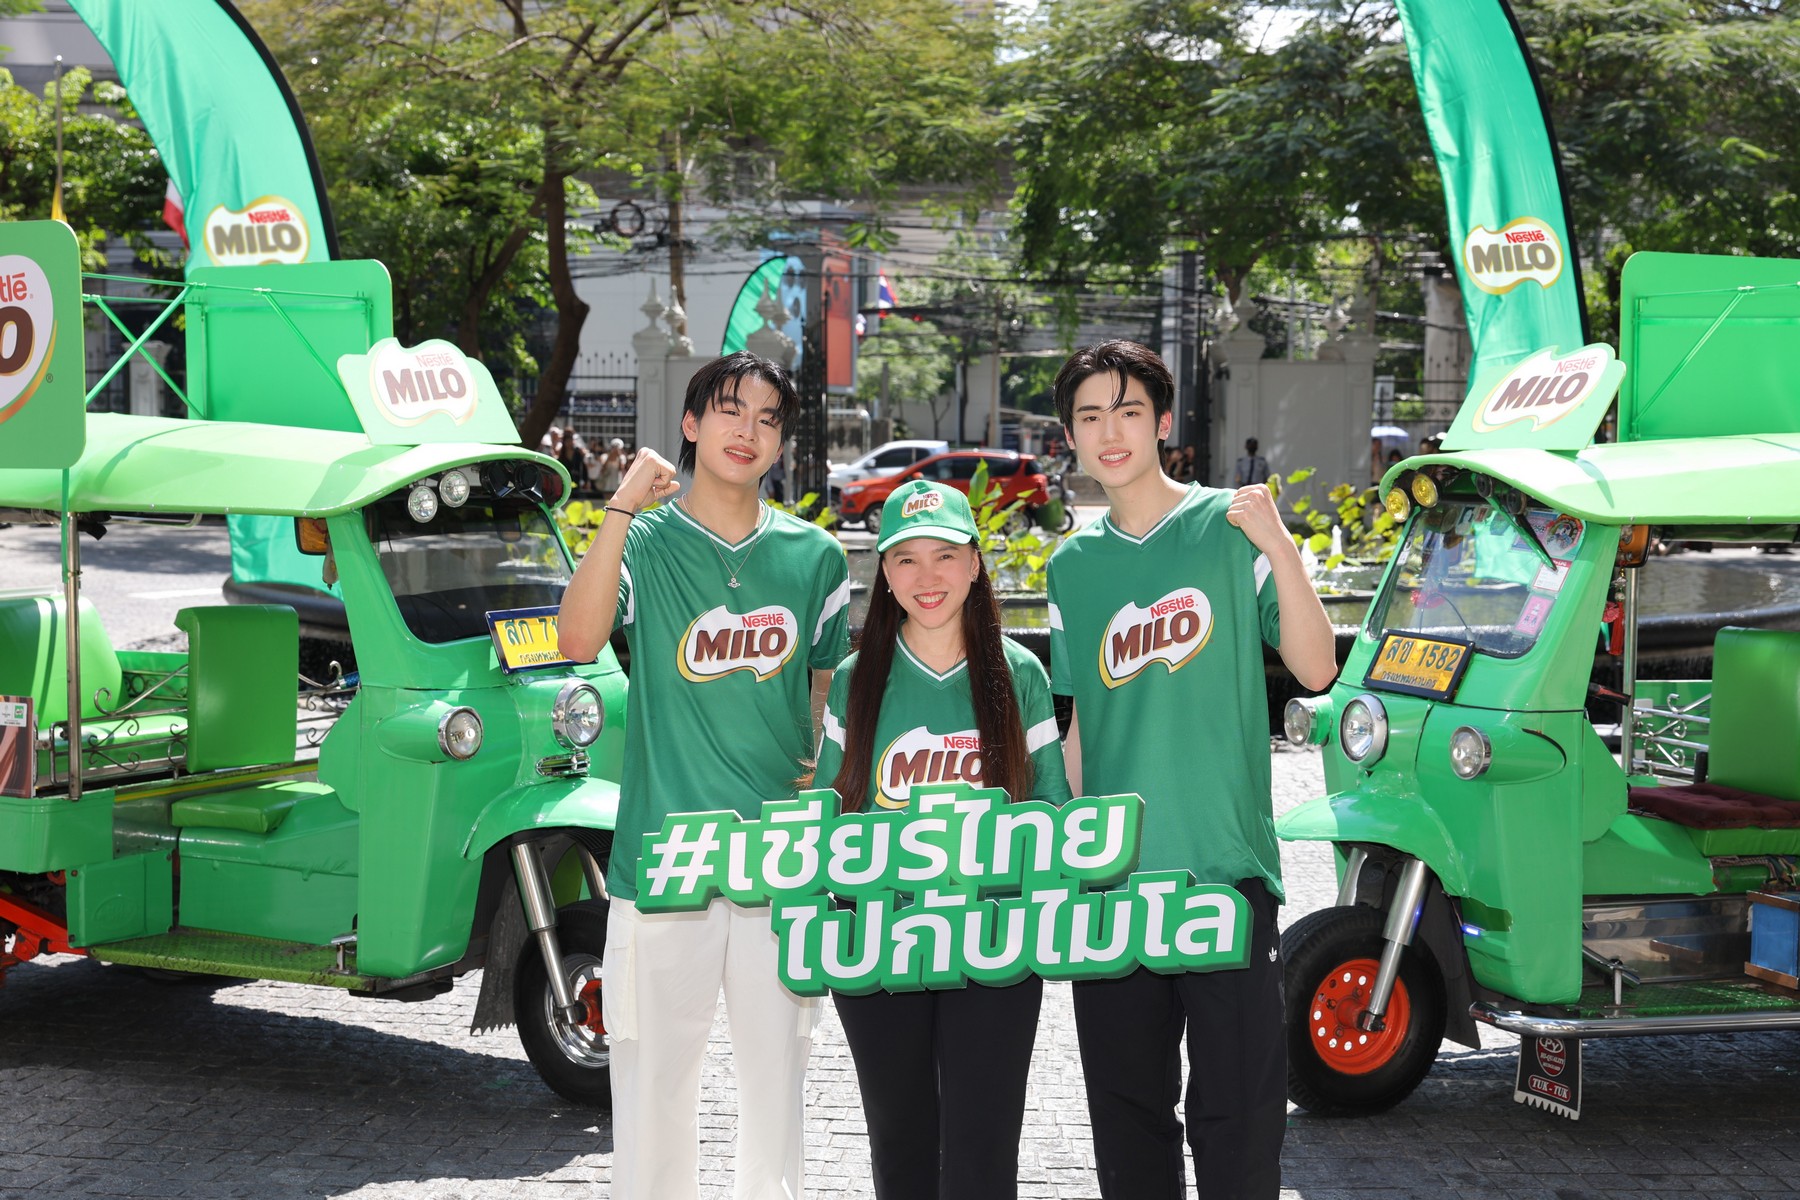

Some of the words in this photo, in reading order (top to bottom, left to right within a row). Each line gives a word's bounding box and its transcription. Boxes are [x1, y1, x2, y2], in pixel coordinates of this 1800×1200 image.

[212, 223, 302, 256] MILO
[1471, 242, 1556, 274] MILO
[382, 367, 467, 405] MILO
[1491, 371, 1589, 412] MILO
[906, 497, 940, 513] MILO
[741, 613, 785, 628] Nestlé
[1150, 595, 1195, 619] Nestlé
[504, 618, 534, 646] สก
[693, 627, 788, 662] MILO
[1111, 610, 1200, 669] MILO
[1419, 643, 1462, 671] 1582
[943, 736, 982, 749] Nest
[889, 749, 984, 788] MILO
[646, 792, 1126, 896] #เชียร์ไทย
[780, 880, 1236, 981] ไปกับไมโล
